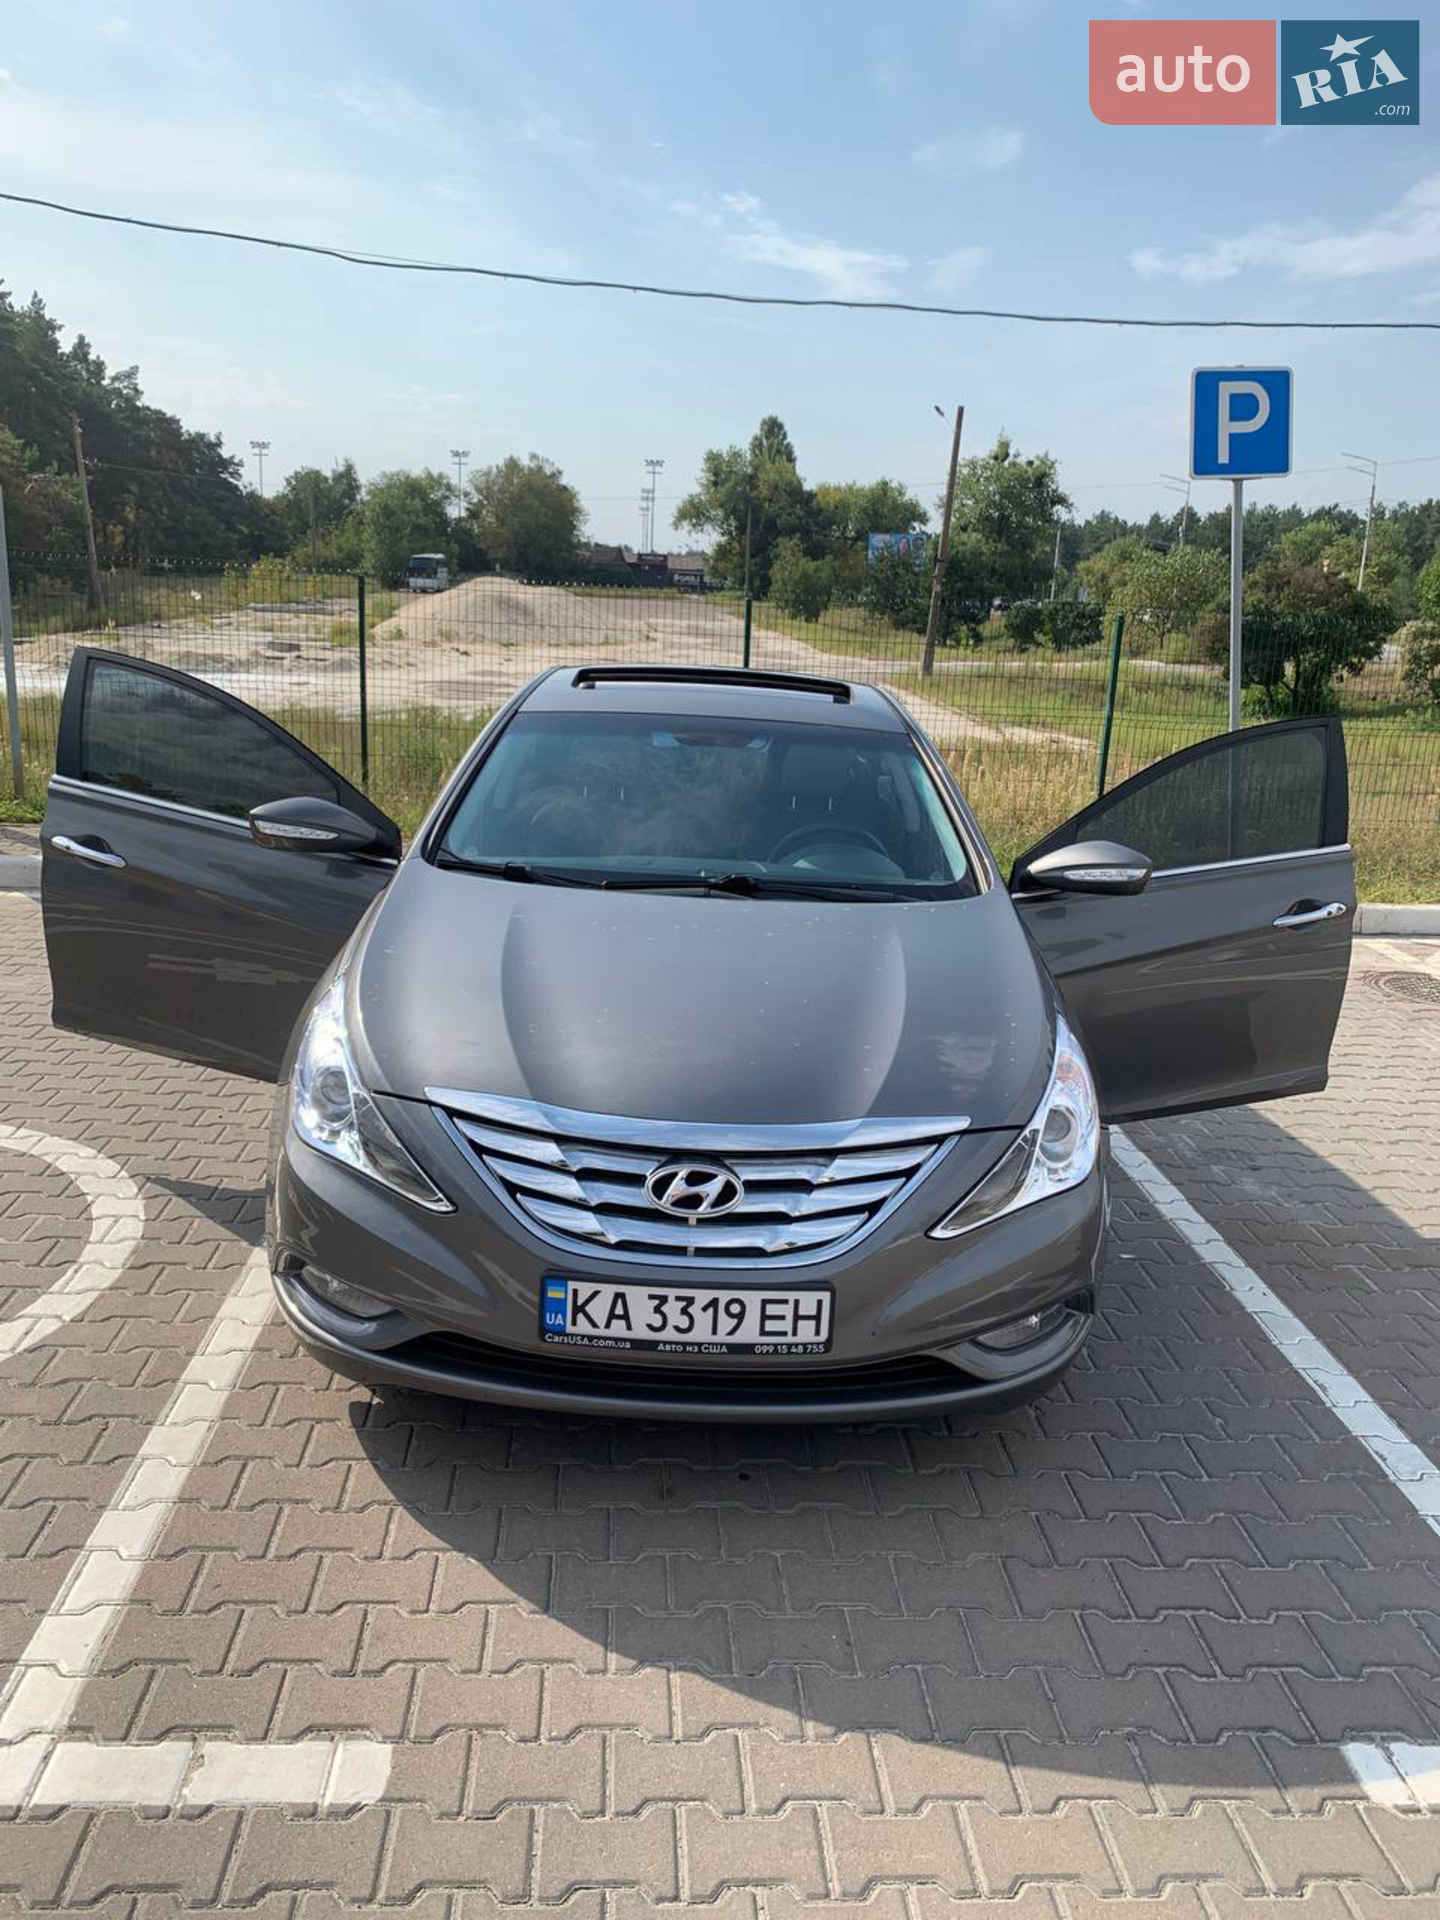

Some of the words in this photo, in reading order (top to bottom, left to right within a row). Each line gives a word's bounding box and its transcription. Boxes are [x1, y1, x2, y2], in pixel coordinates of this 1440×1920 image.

[1217, 380, 1271, 465] P
[545, 1313, 564, 1327] UA
[570, 1288, 633, 1332] KA
[646, 1293, 747, 1336] 3319
[759, 1298, 823, 1338] EH
[545, 1333, 631, 1349] CarsUSA.com.ua
[657, 1342, 684, 1352] Авто
[686, 1344, 699, 1353] из
[701, 1343, 729, 1354] США
[754, 1344, 775, 1354] 099
[776, 1344, 789, 1354] 15
[790, 1344, 804, 1354] 48
